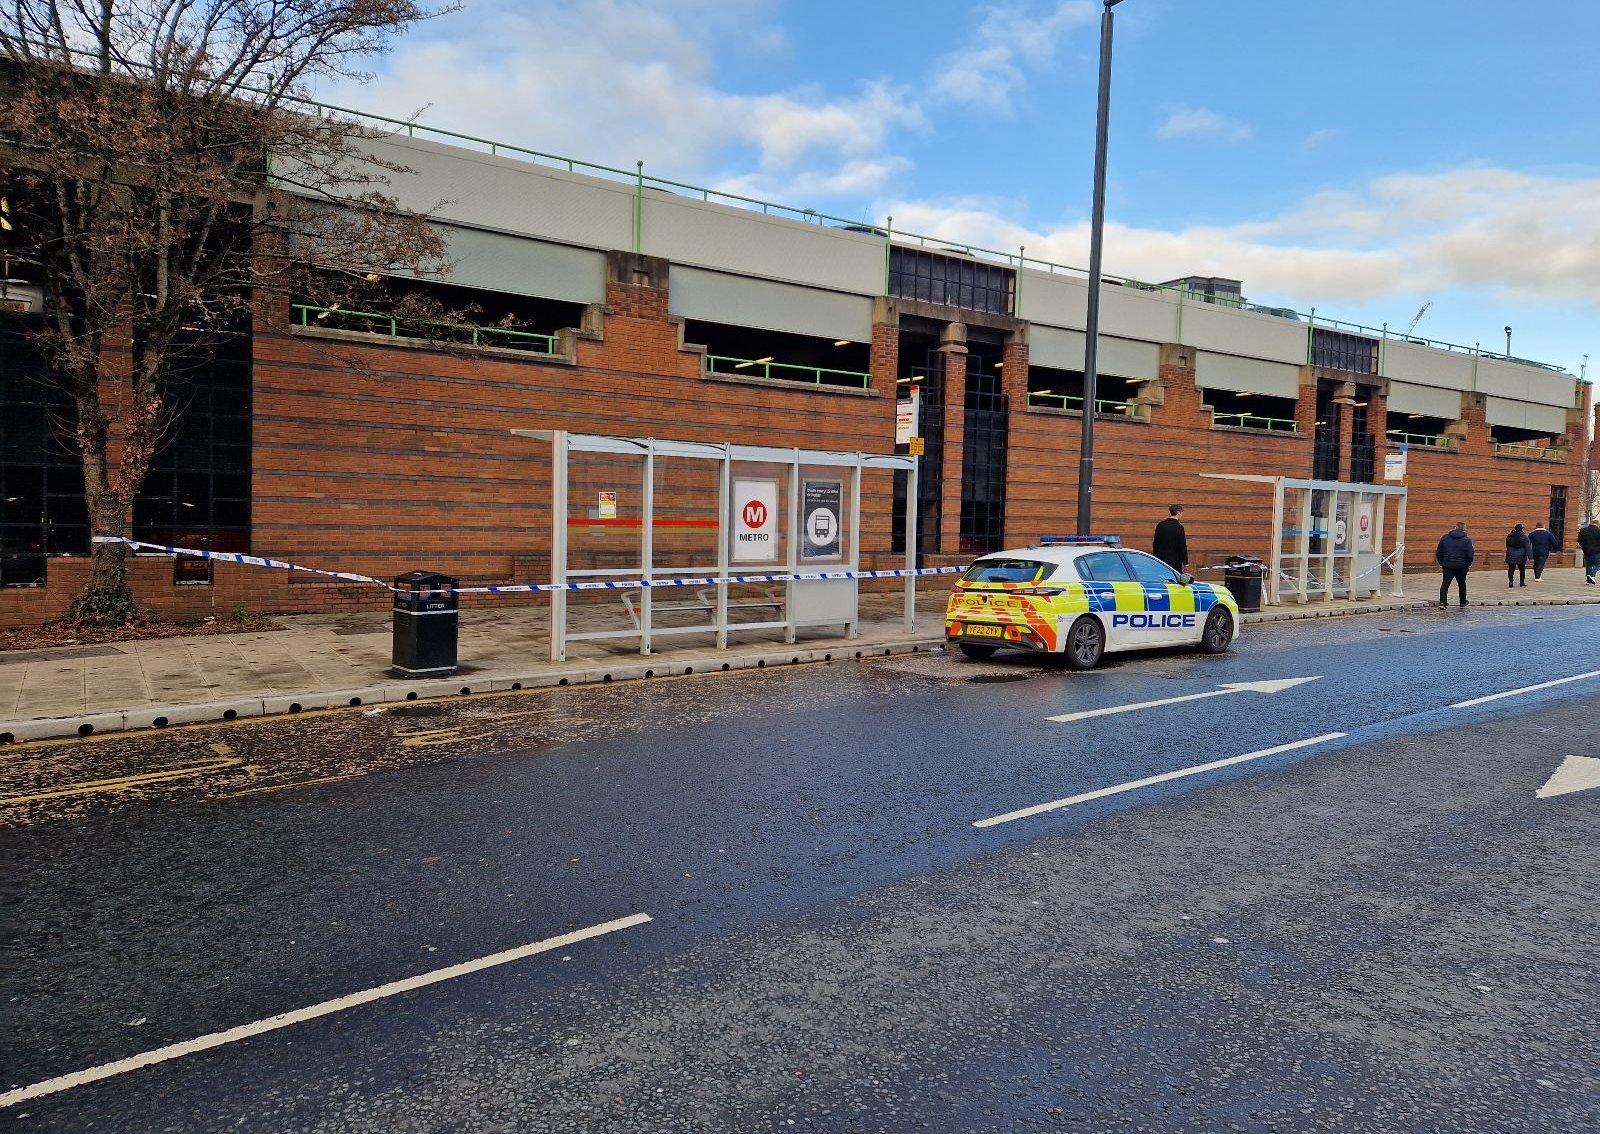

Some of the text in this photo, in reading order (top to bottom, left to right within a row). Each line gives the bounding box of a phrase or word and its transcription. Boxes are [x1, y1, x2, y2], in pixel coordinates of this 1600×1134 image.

[739, 533, 769, 542] METRO
[957, 599, 1016, 607] POLICE
[1112, 614, 1196, 628] POLICE
[969, 625, 985, 635] YF22
